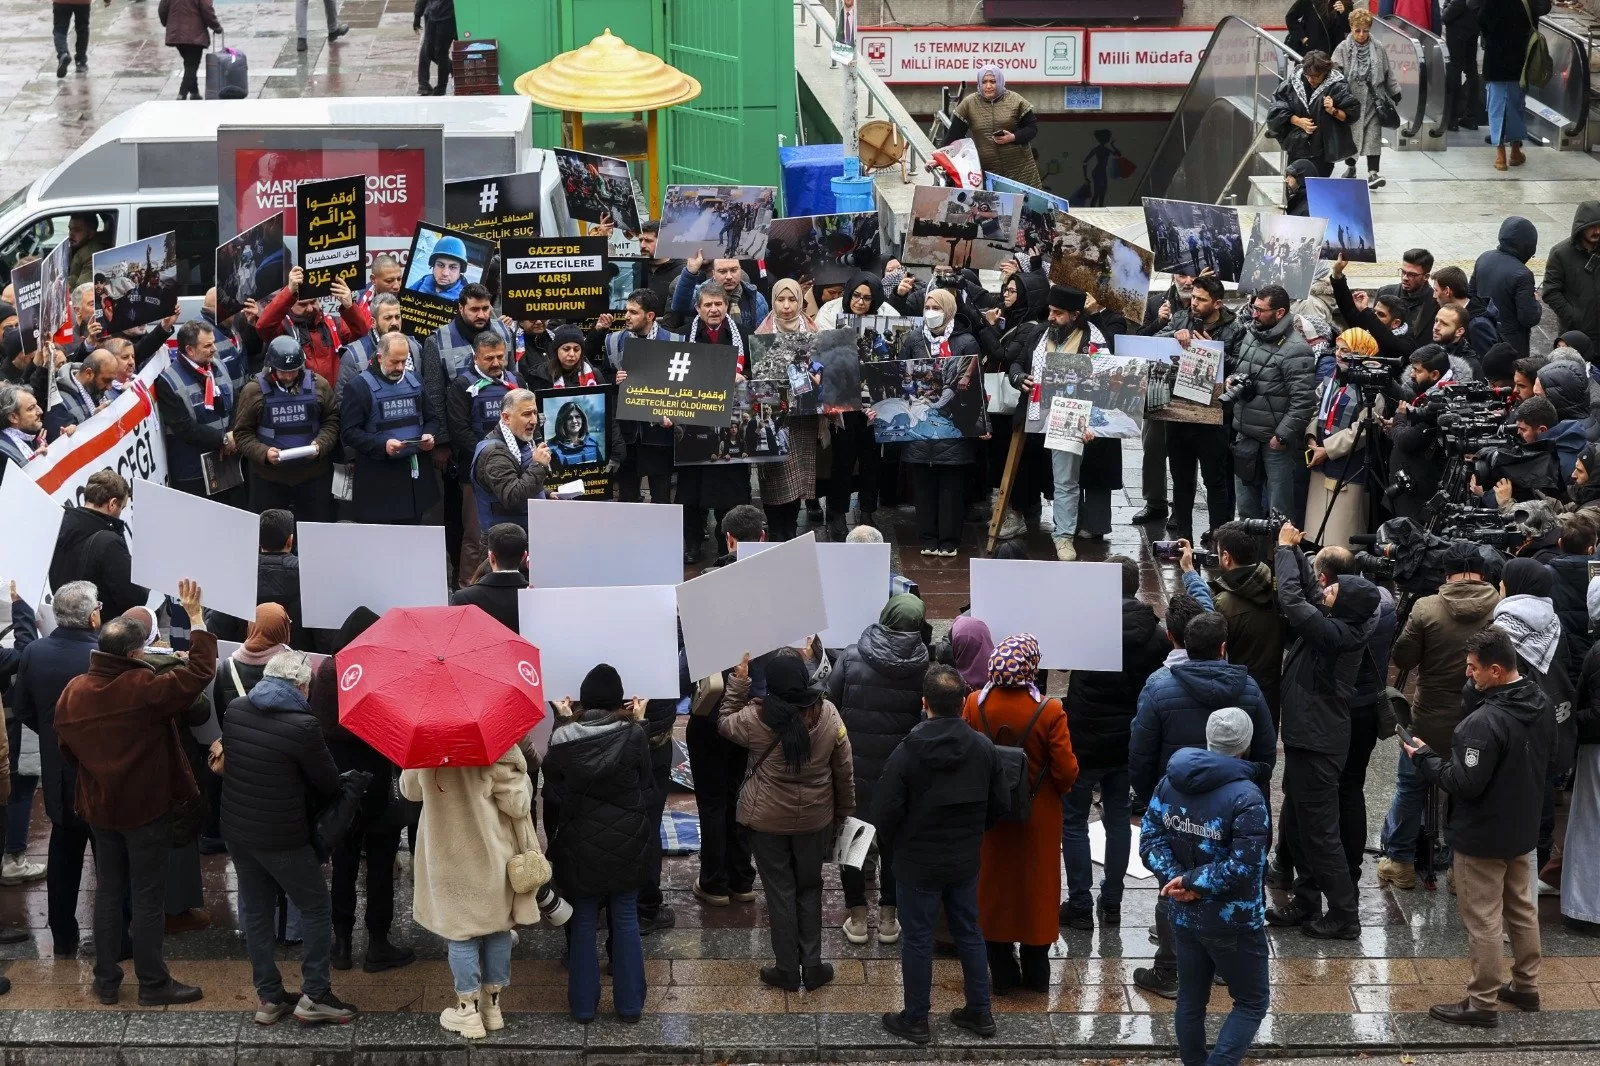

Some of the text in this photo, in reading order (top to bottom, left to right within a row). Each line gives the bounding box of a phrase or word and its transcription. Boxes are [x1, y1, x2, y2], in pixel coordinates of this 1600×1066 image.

[914, 42, 1025, 53] 15 TEMMUZ KIZILAY
[934, 57, 968, 70] İRADE
[1098, 52, 1130, 65] Milli
[1136, 51, 1192, 65] Müdafa
[365, 175, 406, 190] OICE
[307, 187, 356, 211] أوقفوا
[365, 189, 408, 205] ONUS
[479, 183, 499, 213] #
[310, 207, 356, 231] جرائم
[309, 221, 356, 250] الحرب
[513, 226, 534, 237] SUÇ
[308, 249, 357, 264] بحق الصحفيين
[528, 245, 580, 256] GAZZE'DE
[515, 258, 595, 270] GAZETECİLERE
[309, 269, 330, 287] غزة
[539, 274, 571, 285] KARŞI
[508, 286, 603, 300] SAVAŞ SUÇLARINI
[526, 301, 585, 312] DURDURUN
[667, 352, 692, 382] #
[271, 404, 305, 416] BASIN
[383, 399, 414, 409] BASIN
[625, 398, 725, 412] GAZETECİLERİ ÖLDÜRMEYİ
[272, 414, 306, 423] PRESS
[384, 408, 415, 418] PRESS
[653, 408, 695, 418] DURDURUN
[1171, 815, 1222, 840] Columbia
